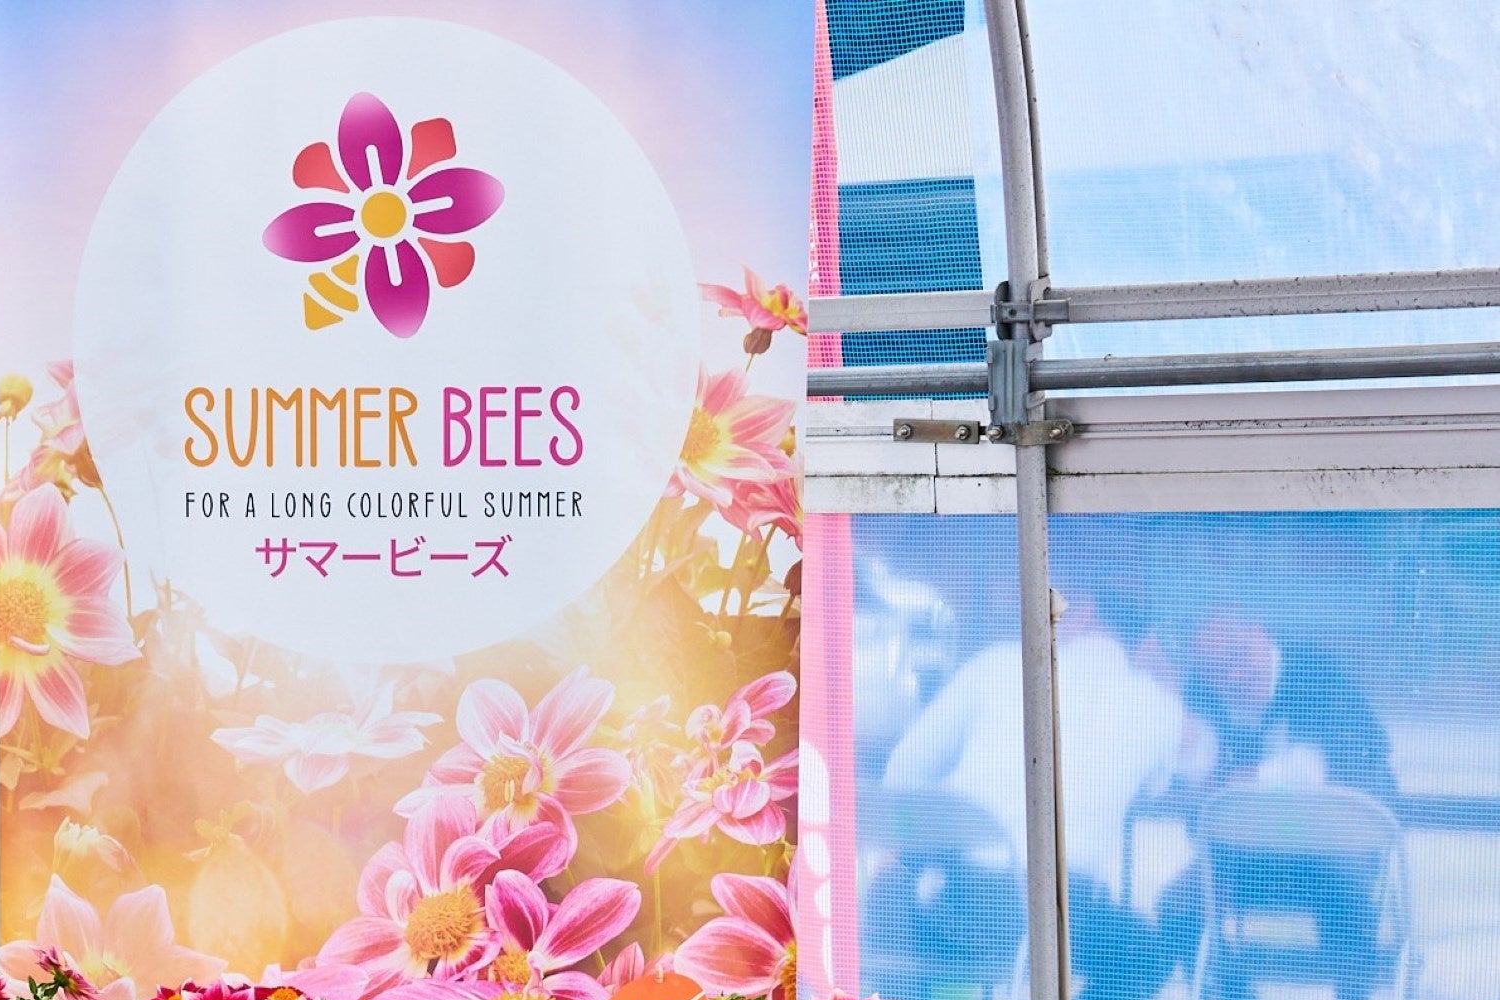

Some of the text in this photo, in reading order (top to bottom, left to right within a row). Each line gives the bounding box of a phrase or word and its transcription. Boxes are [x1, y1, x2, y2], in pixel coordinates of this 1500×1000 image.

[184, 385, 584, 468] SUMMER BEES
[184, 491, 583, 518] FOR A LONG COLORFUL SUMMER
[255, 534, 513, 578] サマービーズ
